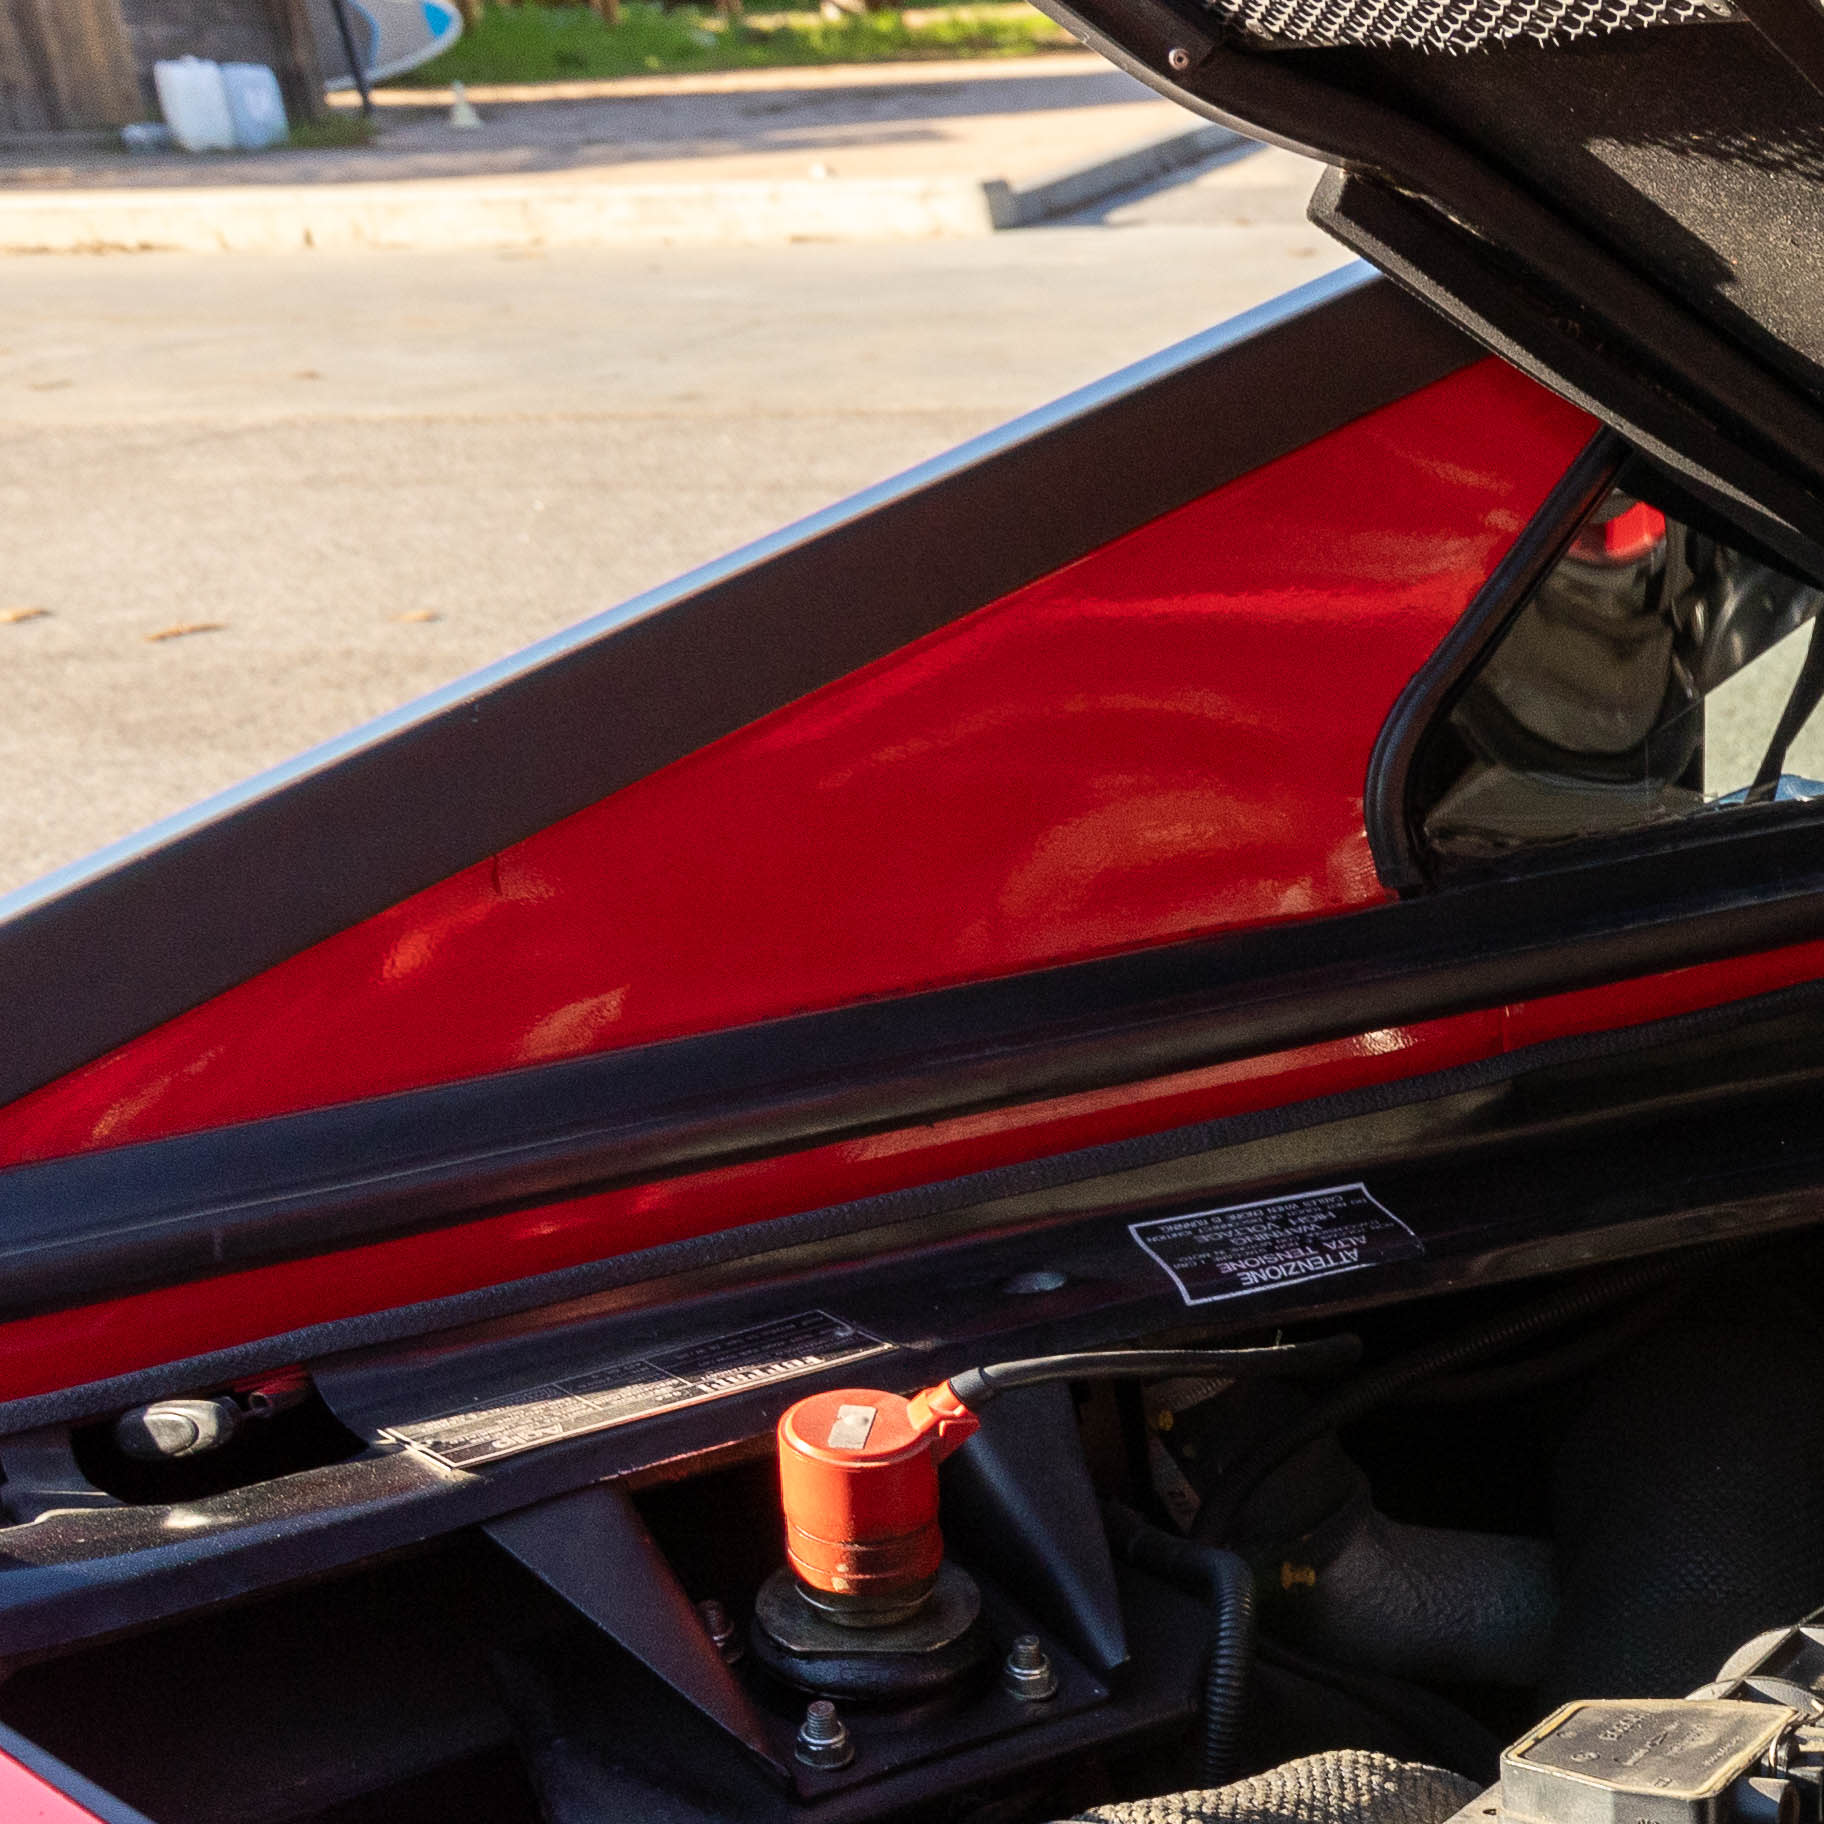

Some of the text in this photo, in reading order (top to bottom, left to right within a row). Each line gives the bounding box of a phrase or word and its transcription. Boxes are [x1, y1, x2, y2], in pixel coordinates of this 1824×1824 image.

[1288, 1210, 1336, 1226] HIGH
[1194, 1222, 1281, 1243] VOLTAGE
[1229, 1223, 1322, 1247] WARNING
[1322, 1235, 1367, 1251] ALTA
[1216, 1246, 1319, 1274] TENSIONE
[1239, 1247, 1360, 1286] ATTENZIONE
